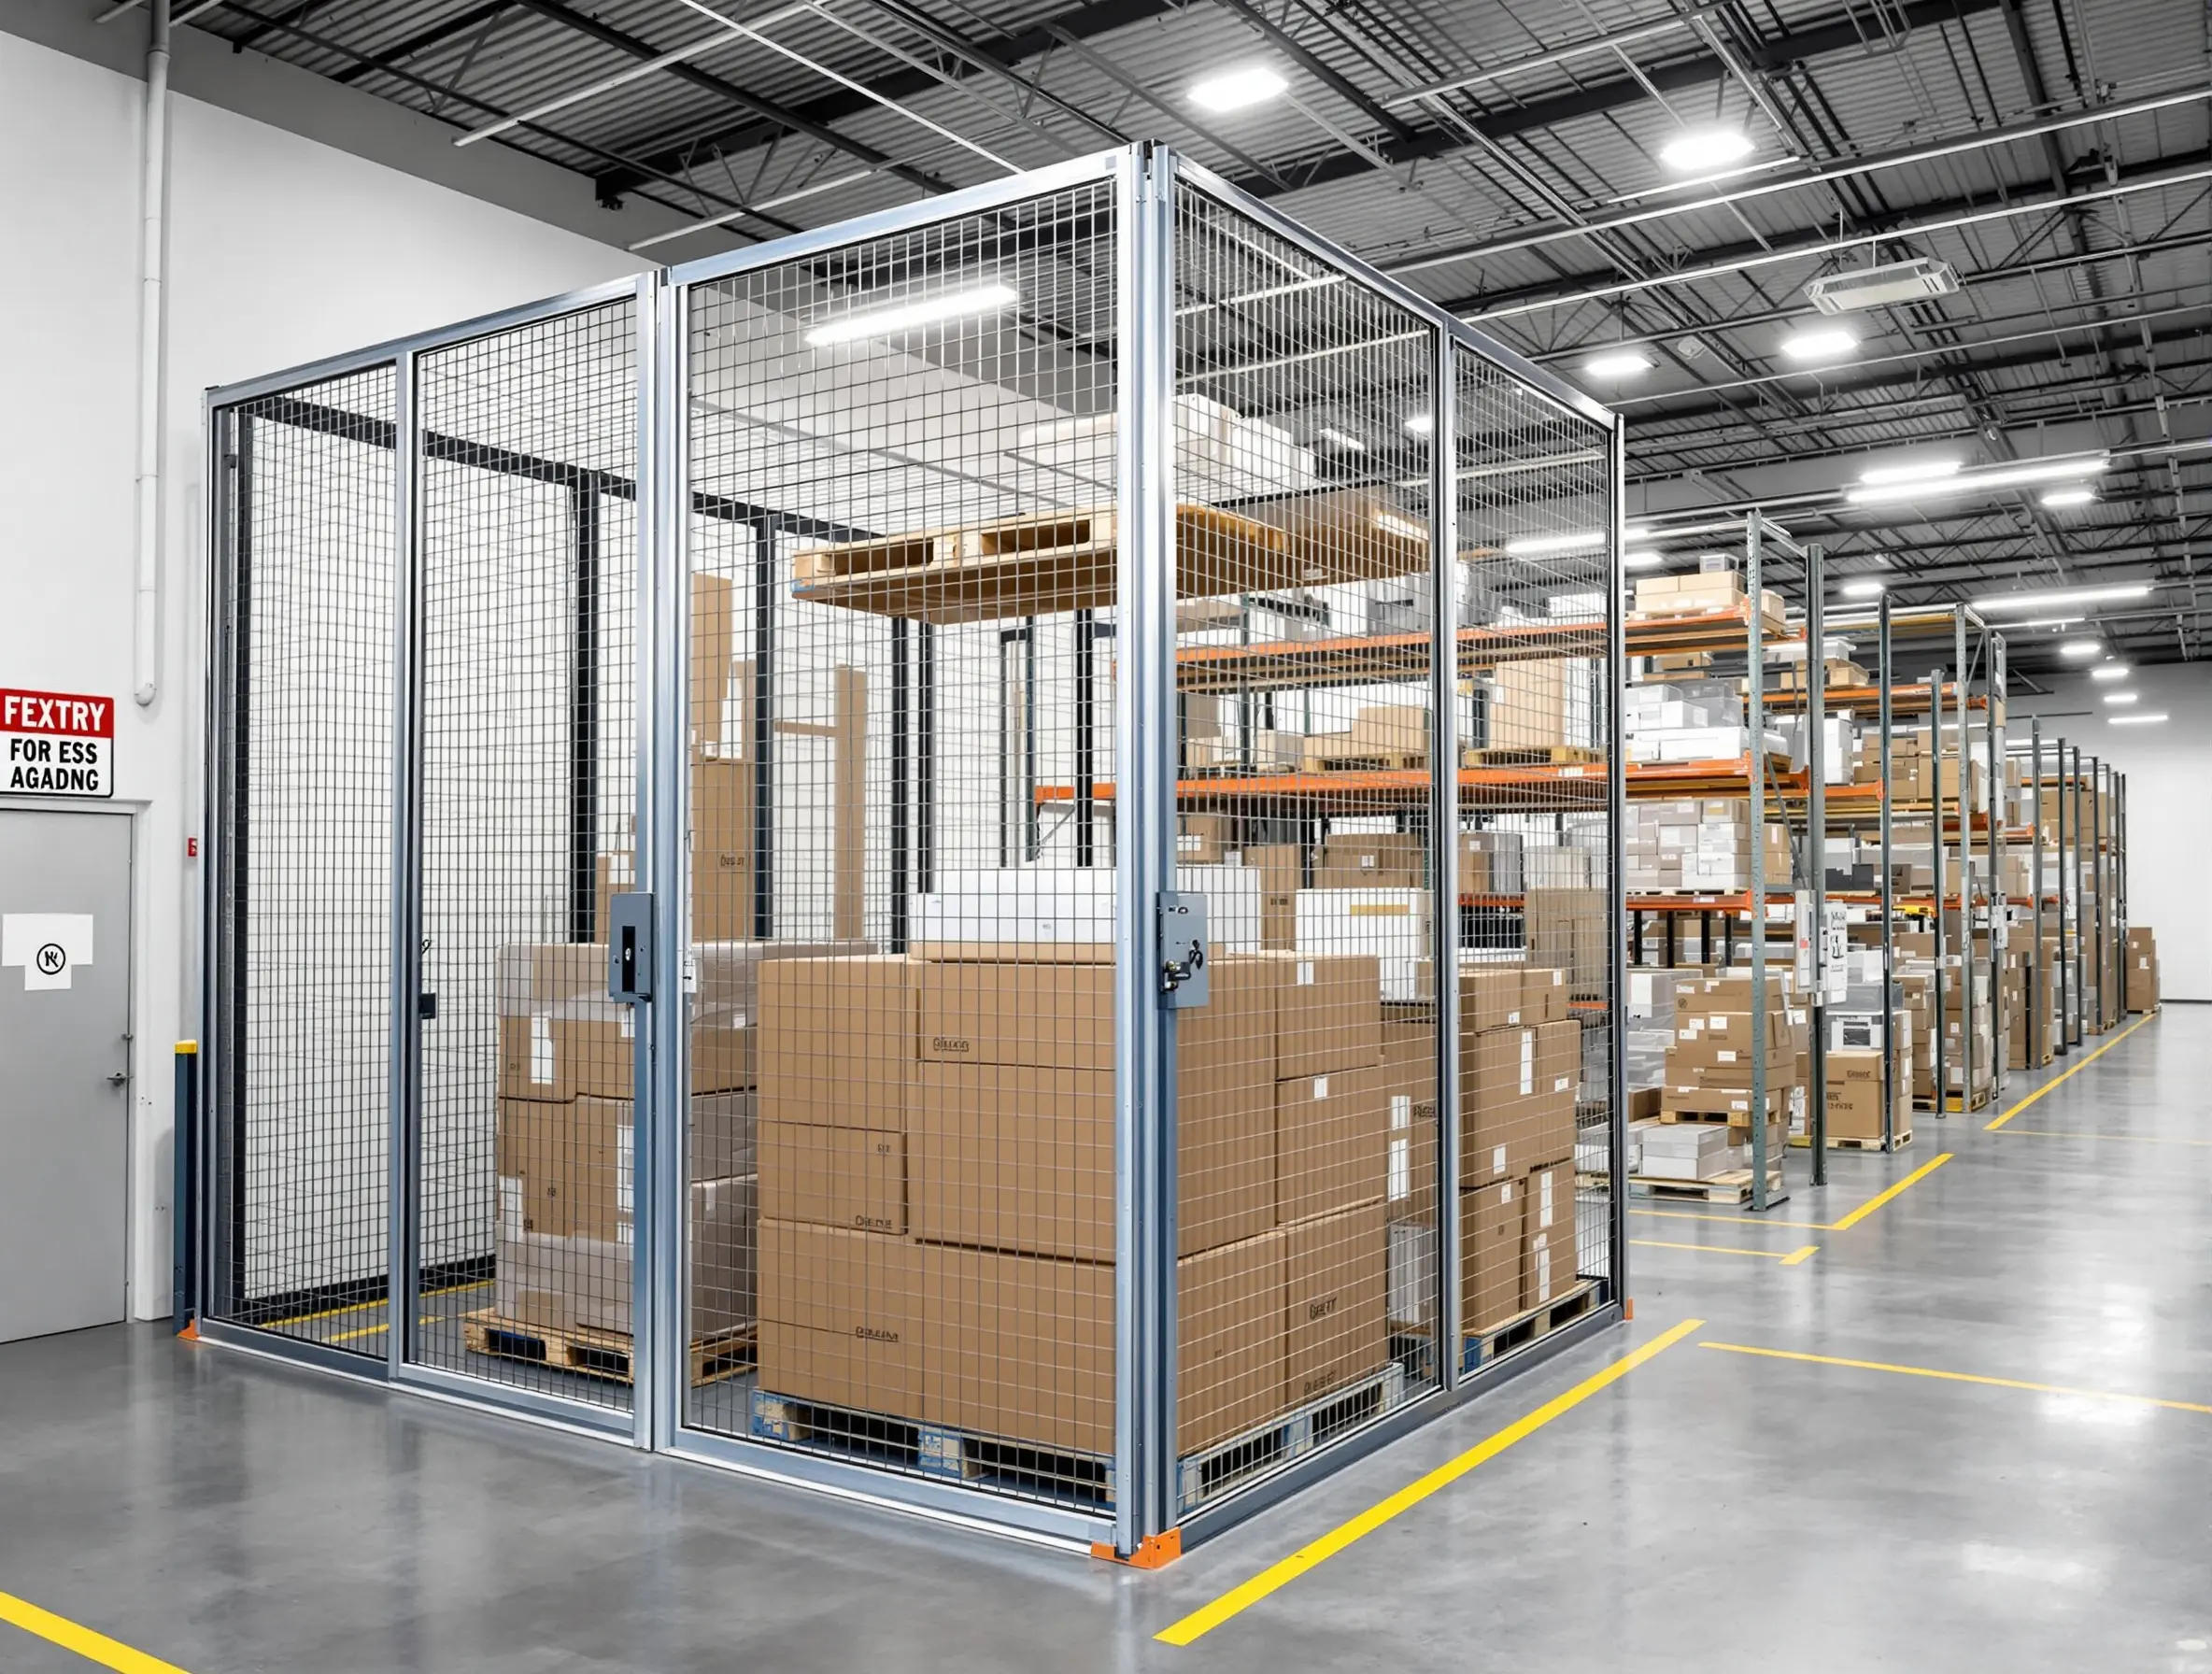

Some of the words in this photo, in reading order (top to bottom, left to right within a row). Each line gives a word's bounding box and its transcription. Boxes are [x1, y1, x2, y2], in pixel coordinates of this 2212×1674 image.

[5, 695, 106, 731] FEXTRY
[10, 738, 51, 762] FOR
[59, 741, 97, 764] ESS
[10, 766, 99, 791] AGADNG
